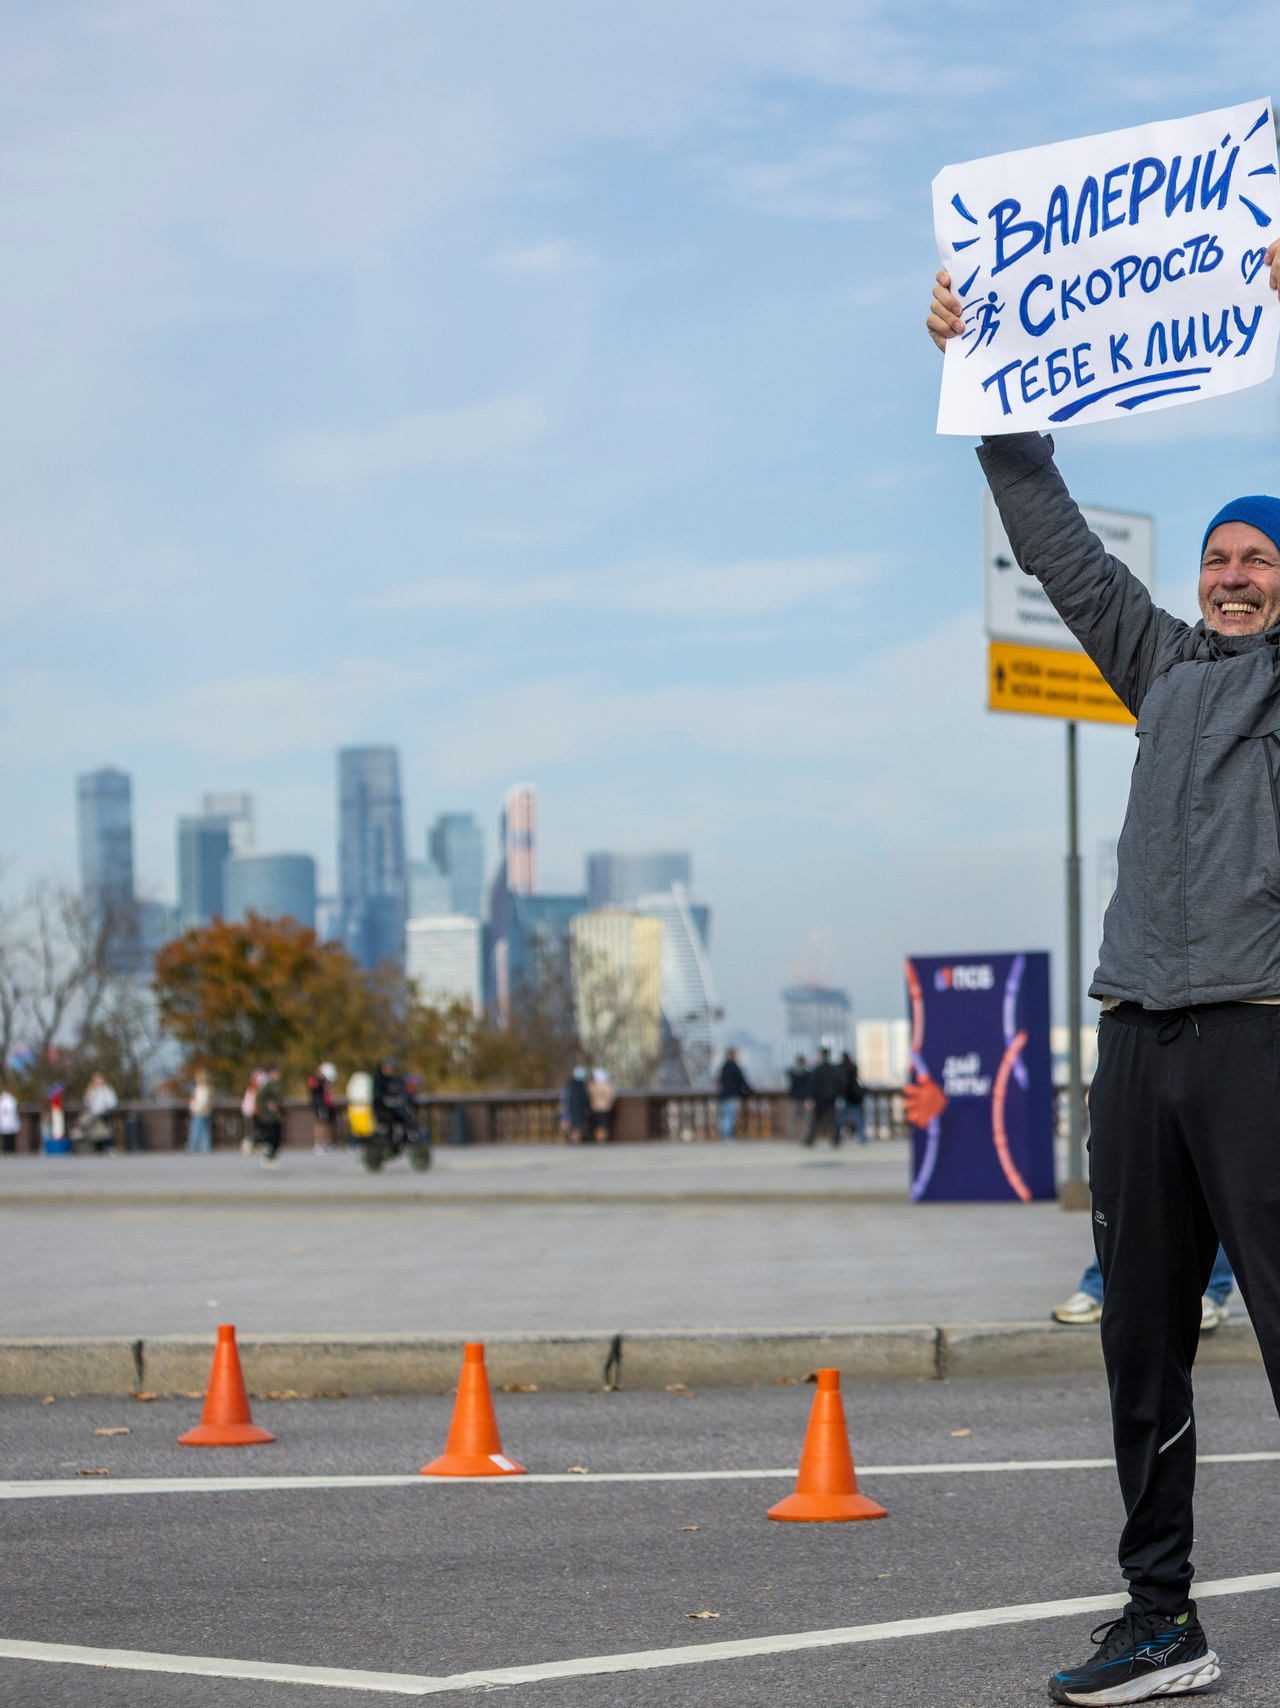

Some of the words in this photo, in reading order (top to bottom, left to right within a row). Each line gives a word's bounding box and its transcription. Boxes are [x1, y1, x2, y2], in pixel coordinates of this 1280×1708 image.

[989, 132, 1240, 277] ВАЛЕРИЙ
[981, 343, 1095, 416] ТЕБЕ
[1144, 304, 1263, 367] ЛИЦУ
